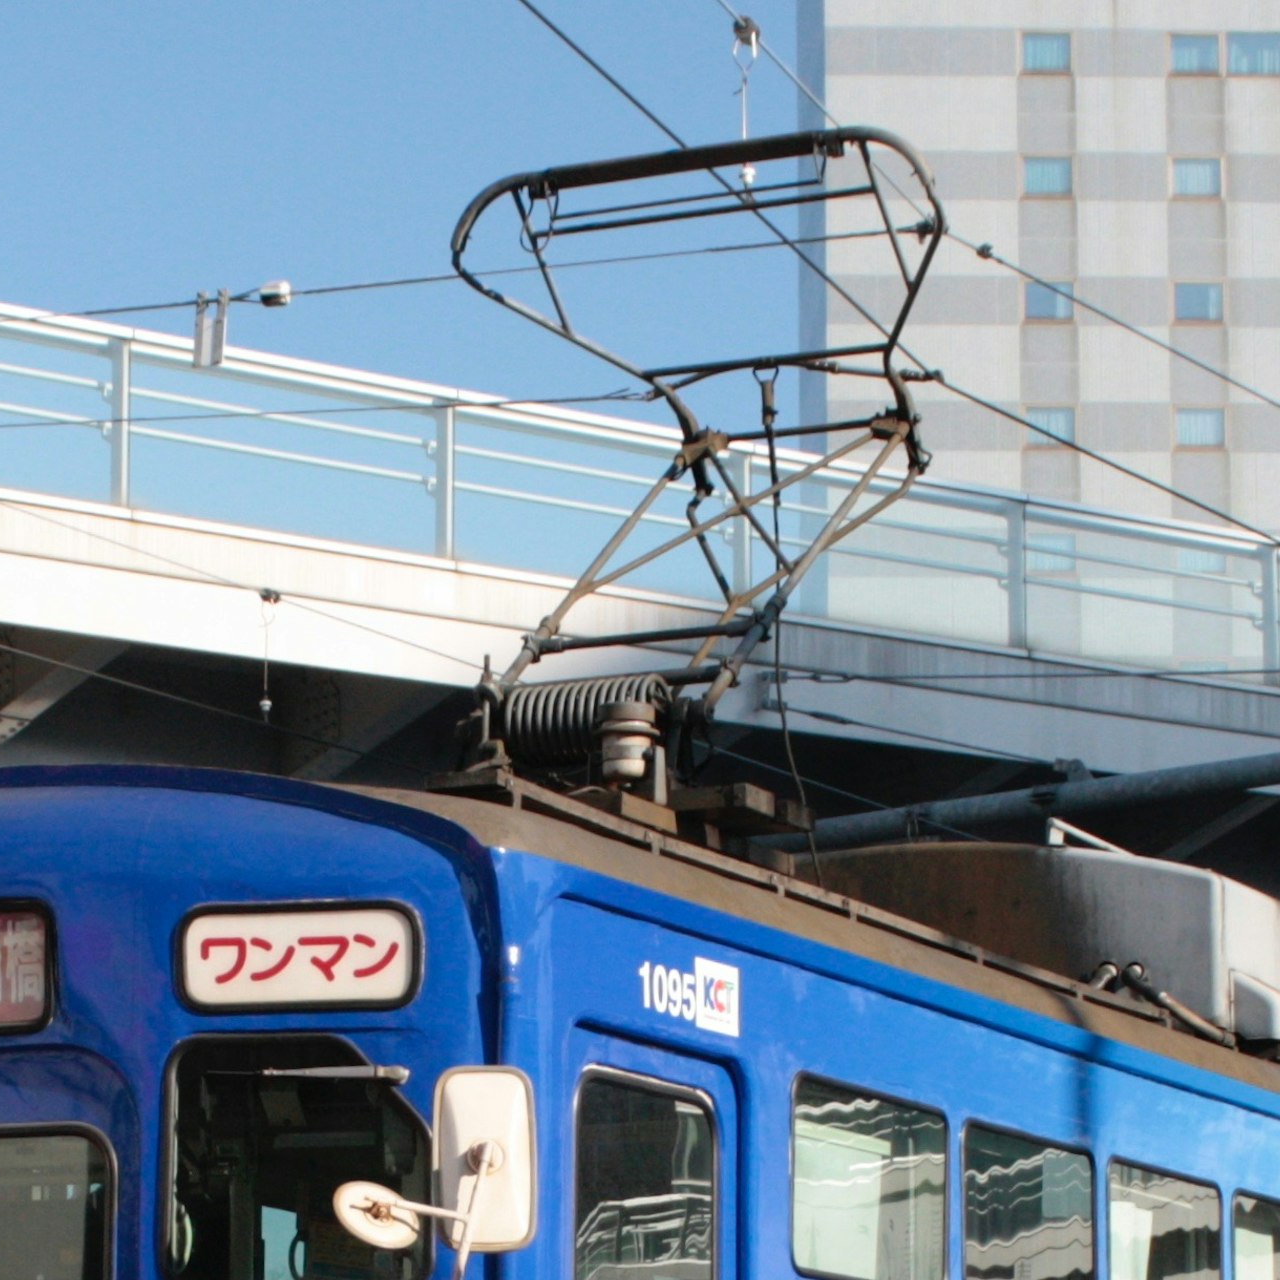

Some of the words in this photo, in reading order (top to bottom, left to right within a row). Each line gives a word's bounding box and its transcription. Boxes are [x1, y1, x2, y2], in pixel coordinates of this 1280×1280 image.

[200, 932, 400, 984] ワンマン
[638, 961, 697, 1021] 1095
